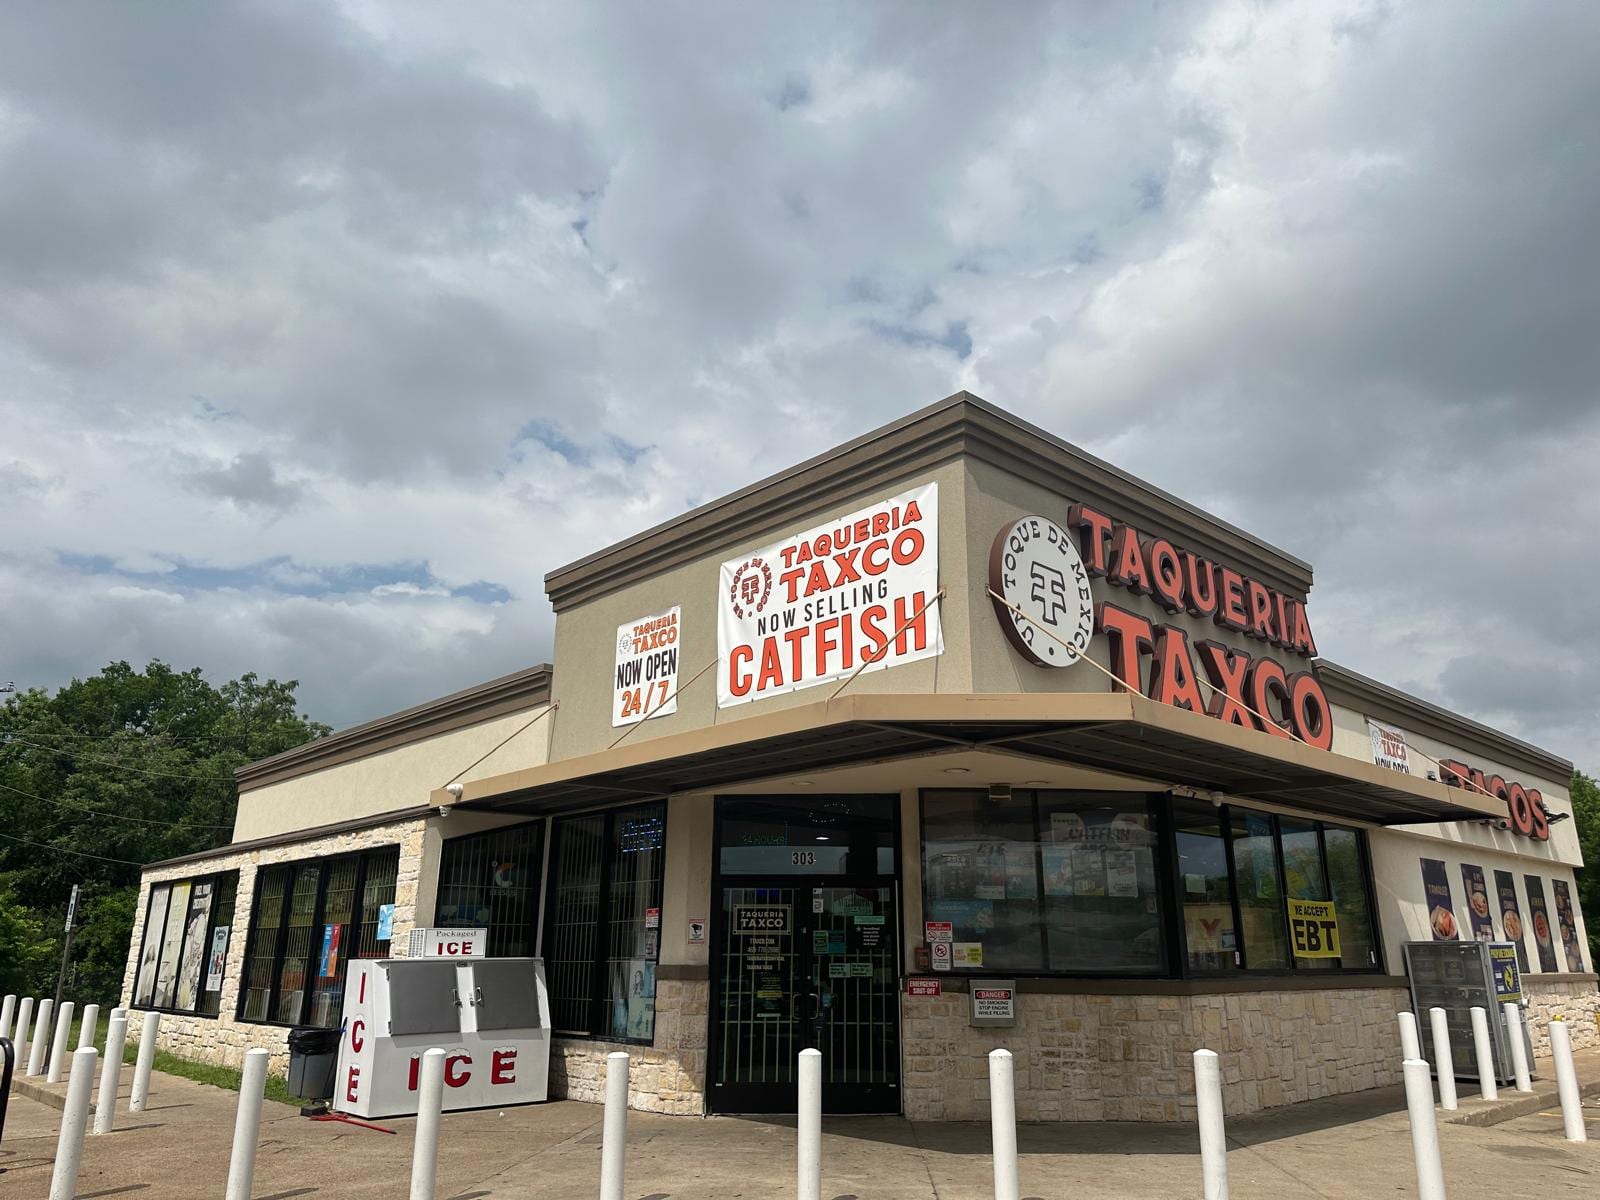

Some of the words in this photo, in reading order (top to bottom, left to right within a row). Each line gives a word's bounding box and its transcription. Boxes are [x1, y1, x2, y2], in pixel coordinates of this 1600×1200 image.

[780, 500, 923, 569] TAQUERIA
[779, 529, 925, 604] TAXCO
[1070, 504, 1318, 658] TAQUERIA
[757, 606, 796, 636] NOW
[804, 578, 889, 621] SELLING
[1004, 520, 1041, 588] TOQUE
[1048, 525, 1069, 555] DE
[1066, 562, 1091, 659] MEXICO
[633, 613, 678, 637] TAQUERIA
[633, 626, 678, 655] TAXCO
[729, 591, 928, 697] CATFISH
[617, 658, 643, 690] NOW
[646, 648, 677, 682] OPEN
[1096, 601, 1334, 751] TAXCO
[792, 852, 814, 865] 303
[740, 918, 784, 928] TAXCO
[1304, 905, 1329, 917] ACCEPT
[436, 930, 477, 939] Packaged
[438, 941, 473, 955] ICE
[1292, 919, 1337, 952] EBT
[909, 980, 939, 988] EMERGENCY
[408, 1046, 517, 1091] ICE
